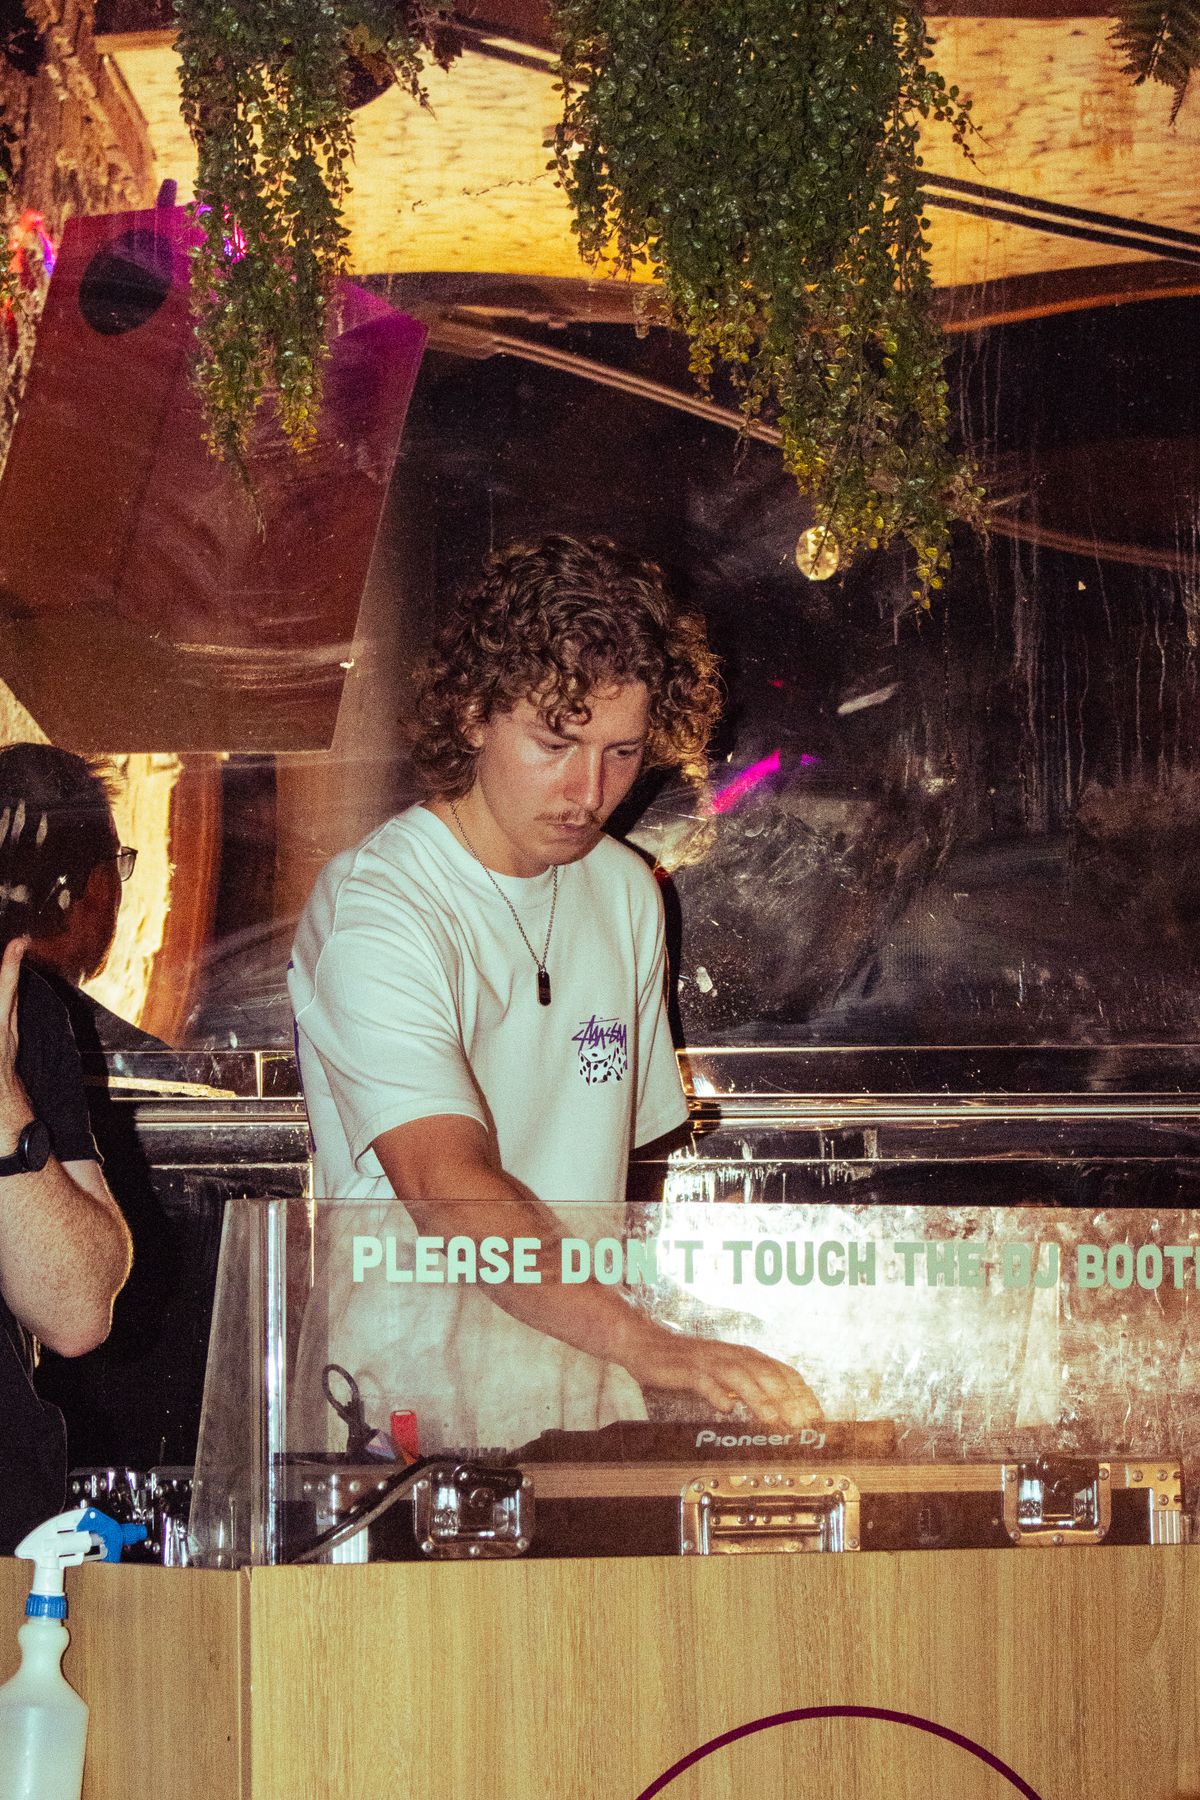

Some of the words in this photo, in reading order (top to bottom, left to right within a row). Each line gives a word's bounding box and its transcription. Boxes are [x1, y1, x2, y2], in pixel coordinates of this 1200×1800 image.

[353, 1236, 541, 1284] PLEASE
[561, 1237, 704, 1286] DON'T
[723, 1240, 876, 1286] TOUCH
[894, 1241, 986, 1287] THE
[1004, 1243, 1060, 1288] DJ
[1077, 1244, 1200, 1289] BOOT
[695, 1429, 793, 1448] Pioneer
